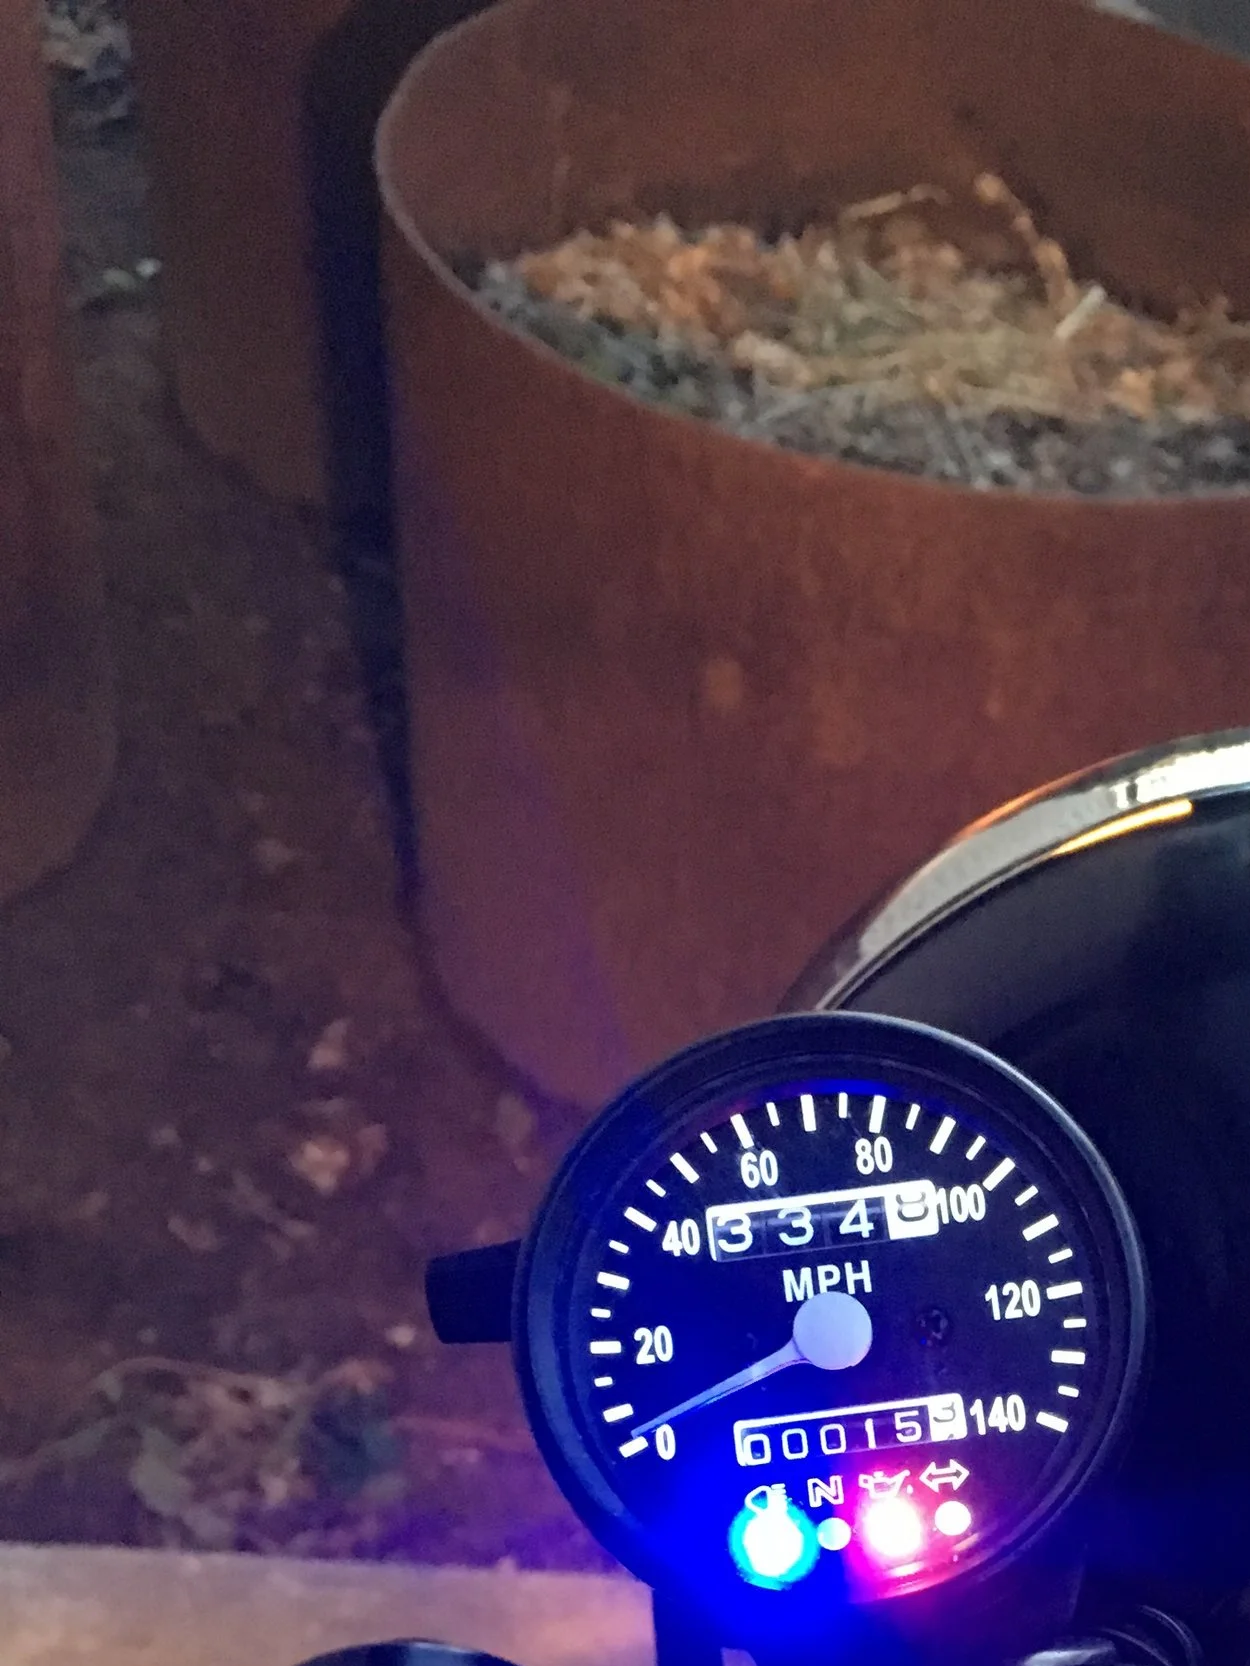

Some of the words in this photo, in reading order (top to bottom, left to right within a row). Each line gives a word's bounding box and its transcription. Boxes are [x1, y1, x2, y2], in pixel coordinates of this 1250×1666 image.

[740, 1150, 778, 1188] 60
[855, 1136, 893, 1175] 80
[934, 1185, 986, 1224] 100
[661, 1218, 700, 1257] 40
[782, 1260, 873, 1303] MPH
[985, 1280, 1041, 1320] 120
[634, 1326, 673, 1364] 20
[969, 1395, 1027, 1436] 140
[655, 1424, 676, 1461] 0
[807, 1475, 844, 1507] N
